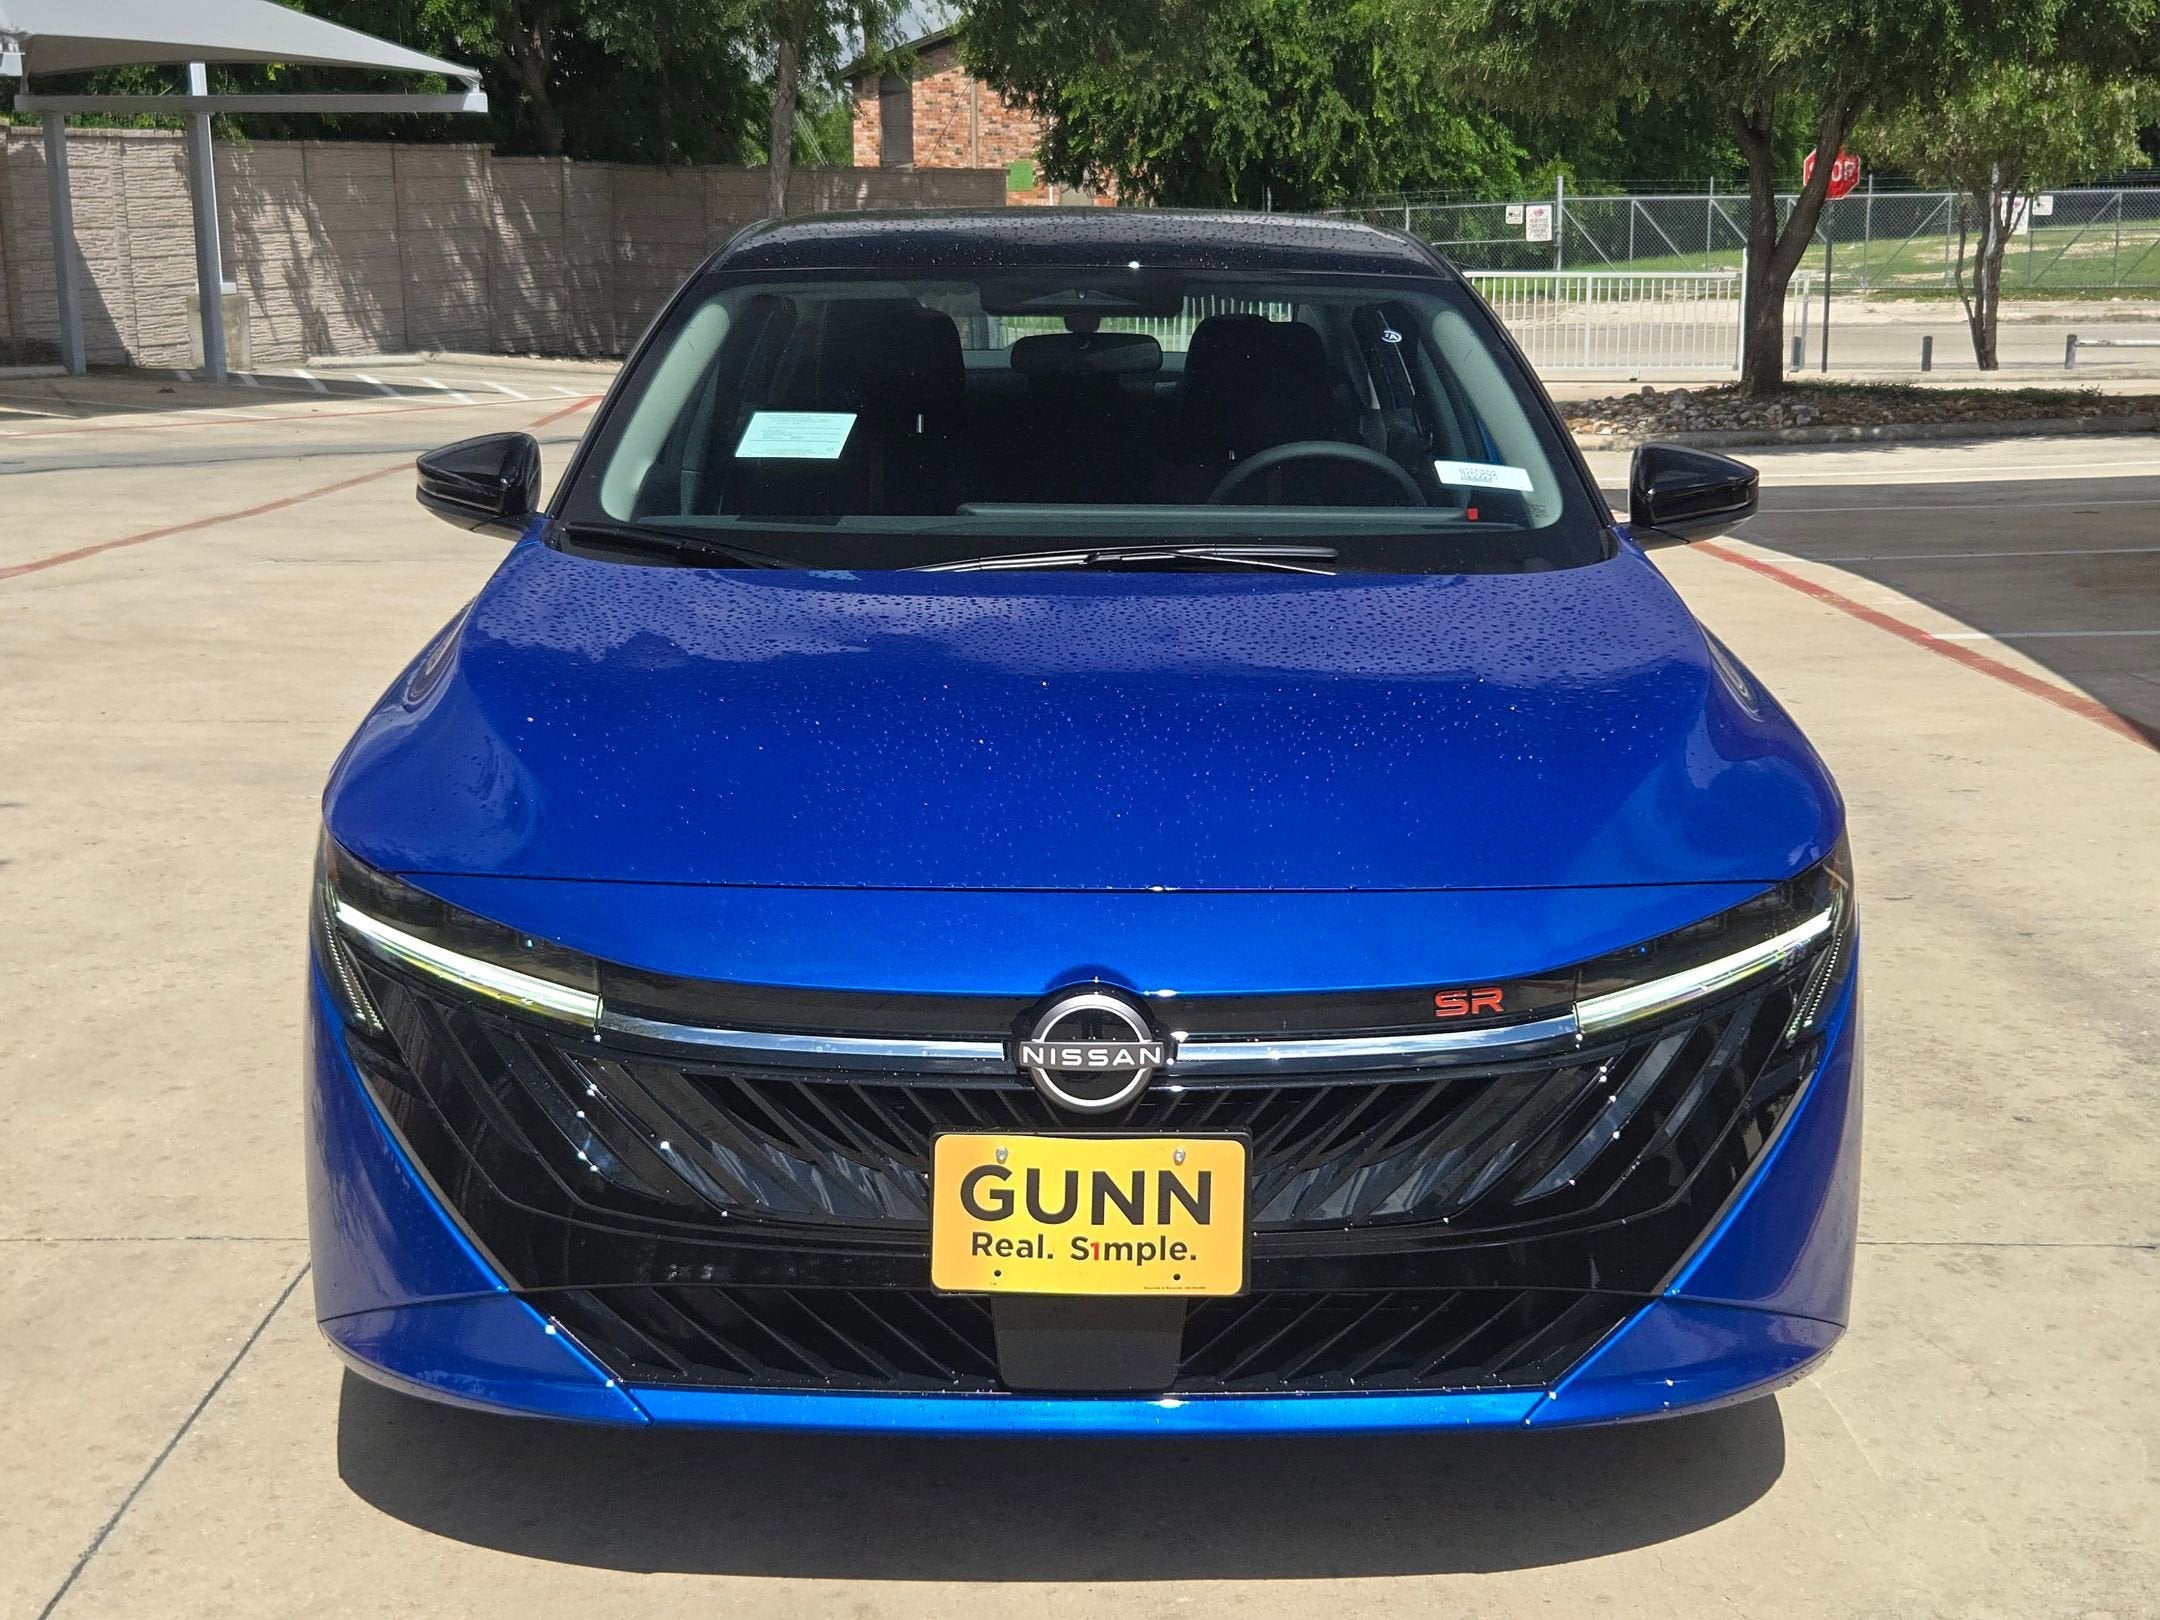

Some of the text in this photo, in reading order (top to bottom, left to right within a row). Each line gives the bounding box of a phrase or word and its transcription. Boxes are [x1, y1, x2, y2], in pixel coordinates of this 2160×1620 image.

[1808, 159, 1856, 182] OP
[1434, 986, 1504, 1017] SR
[1022, 1046, 1161, 1067] NISSAN
[960, 1164, 1212, 1226] GUNN
[971, 1231, 1054, 1260] Real.
